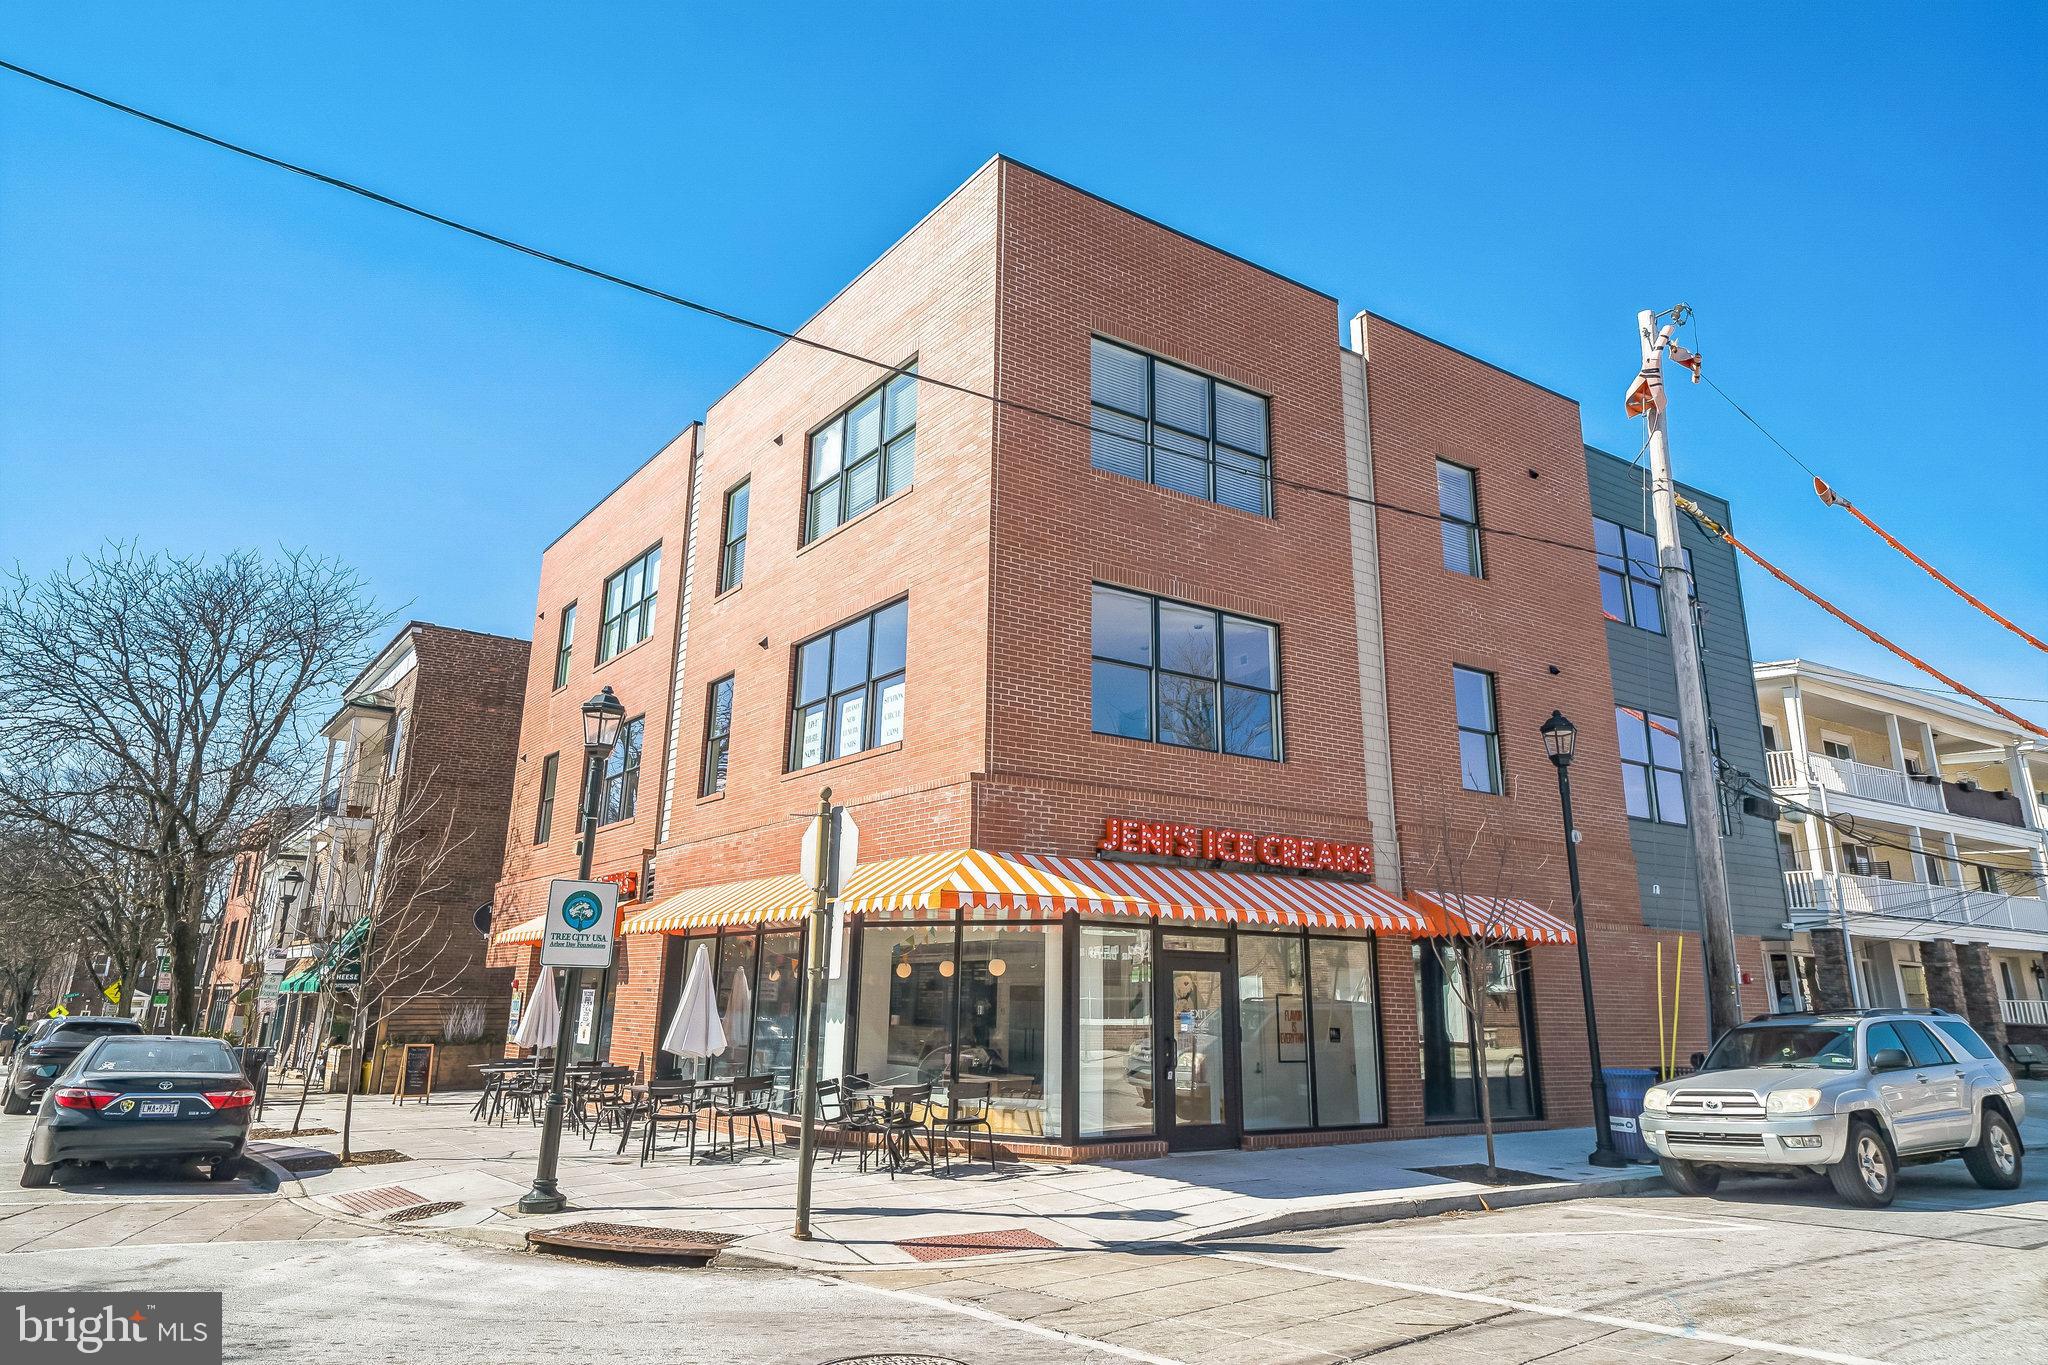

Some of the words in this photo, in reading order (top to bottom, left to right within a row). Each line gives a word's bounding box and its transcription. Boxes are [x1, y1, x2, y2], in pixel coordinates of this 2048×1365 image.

[1098, 816, 1198, 857] JENI'S
[1202, 828, 1256, 863] ICE
[1257, 835, 1374, 874] CREAMS
[551, 932, 571, 940] TREE
[572, 933, 590, 941] CITY
[592, 934, 608, 942] USA
[566, 941, 576, 949] Day
